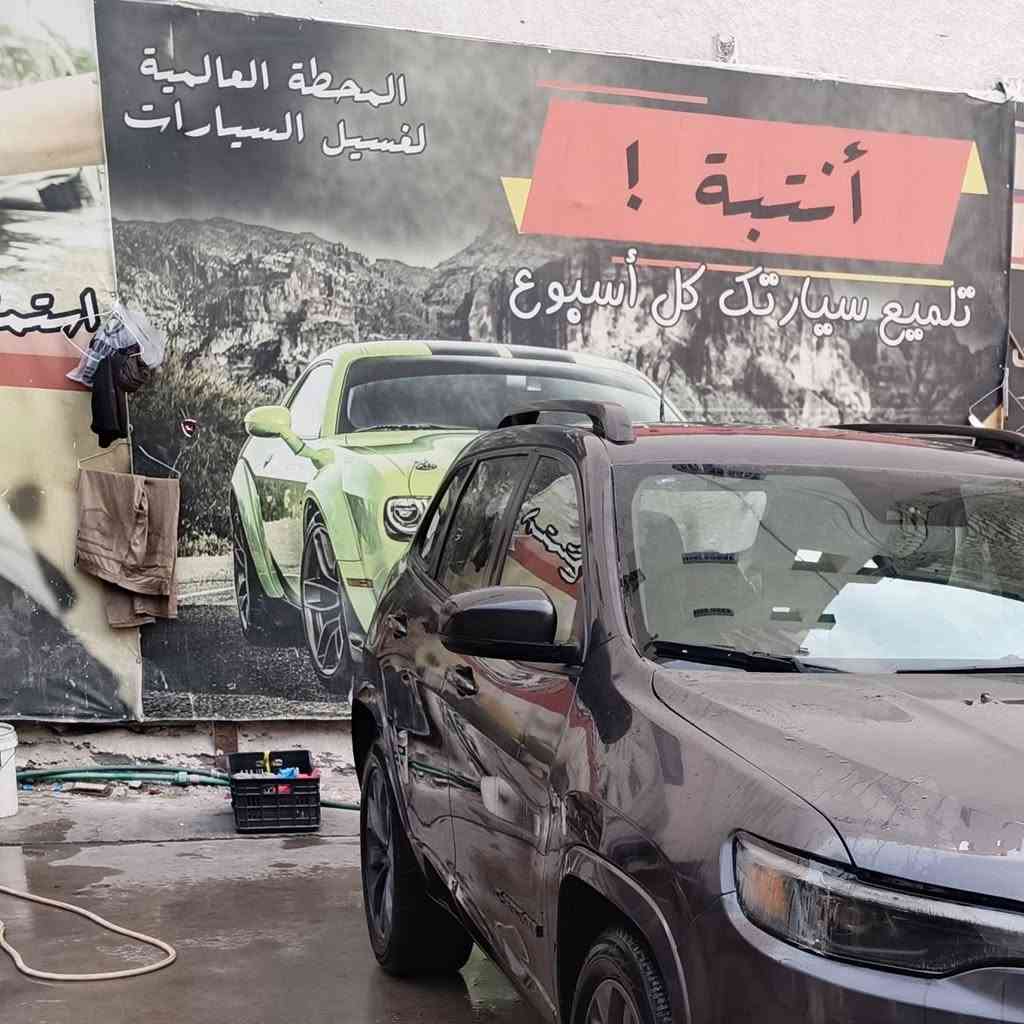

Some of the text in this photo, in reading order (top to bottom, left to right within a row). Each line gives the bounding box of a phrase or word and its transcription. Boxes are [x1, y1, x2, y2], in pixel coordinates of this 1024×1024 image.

[140, 47, 409, 107] المحطة العالمية
[124, 99, 304, 149] السيارات
[508, 247, 976, 346] تلميع سيارتك كل أسبوع
